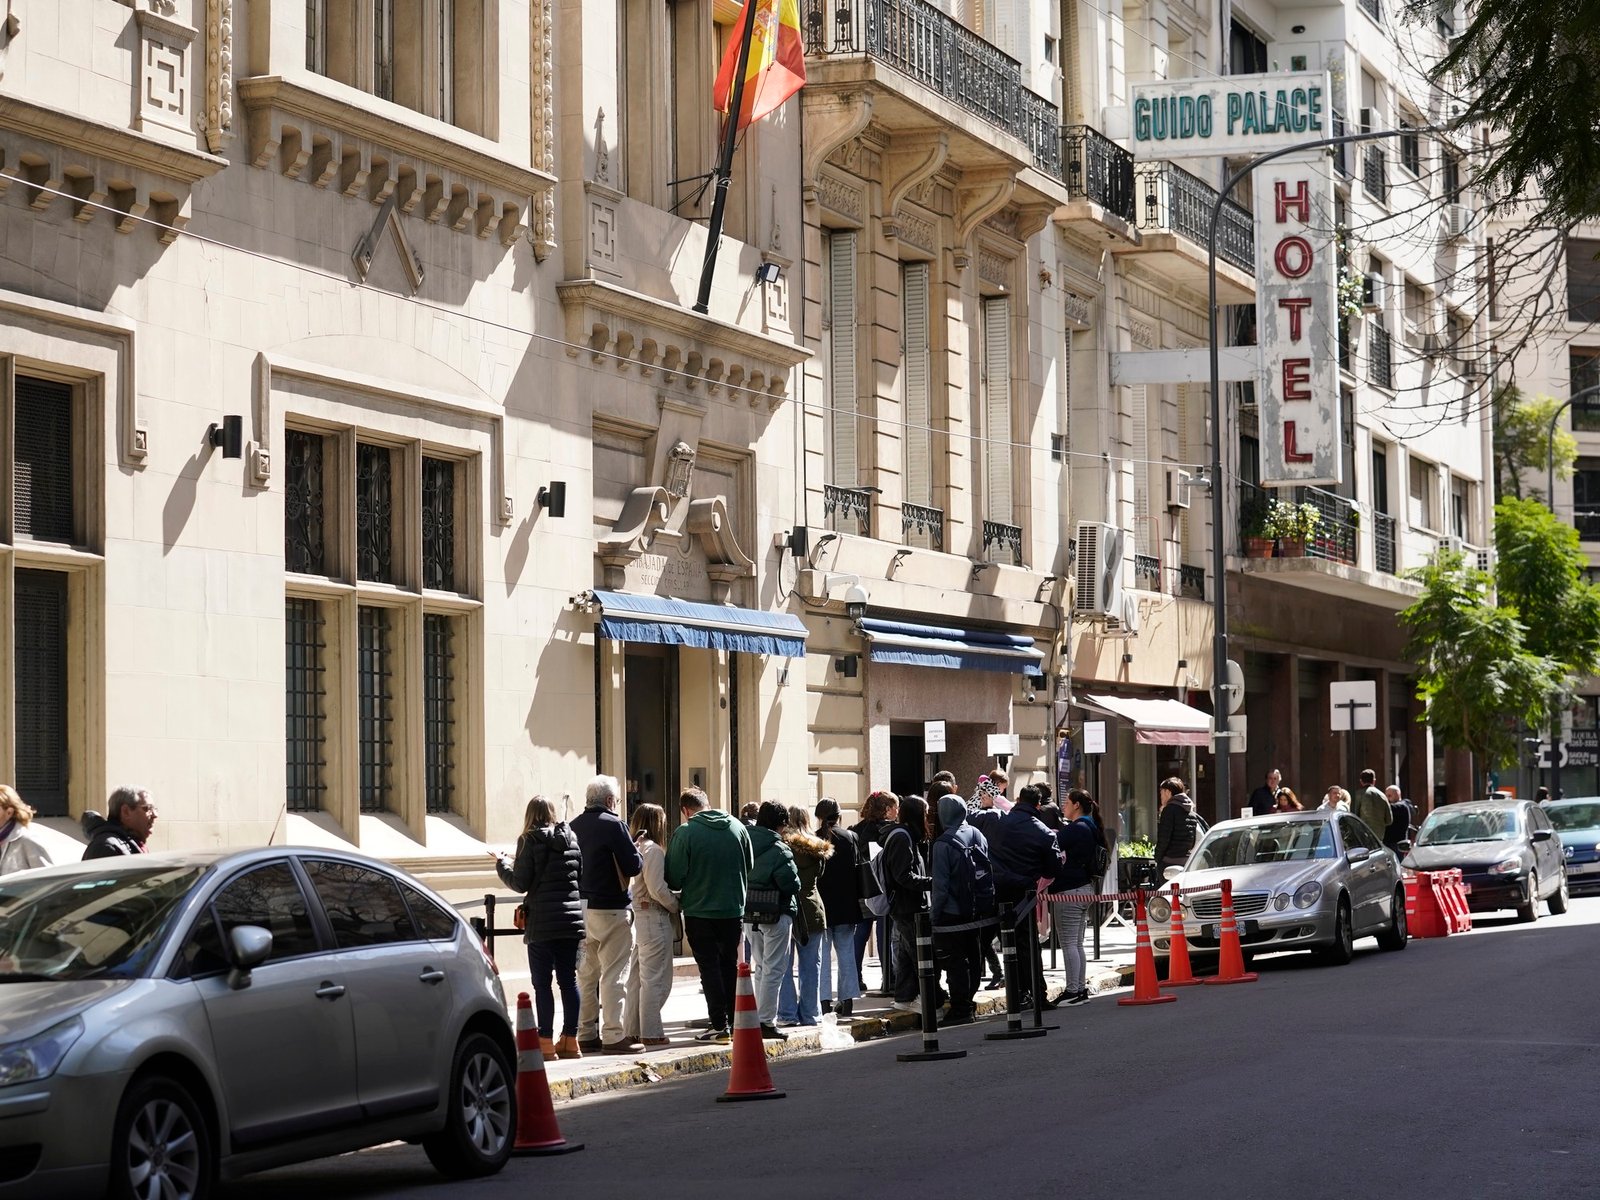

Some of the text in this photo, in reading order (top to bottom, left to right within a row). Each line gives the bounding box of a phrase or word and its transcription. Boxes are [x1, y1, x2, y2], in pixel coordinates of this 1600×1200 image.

[1135, 87, 1322, 142] GUIDO PALACE
[1274, 180, 1314, 464] HOTEL
